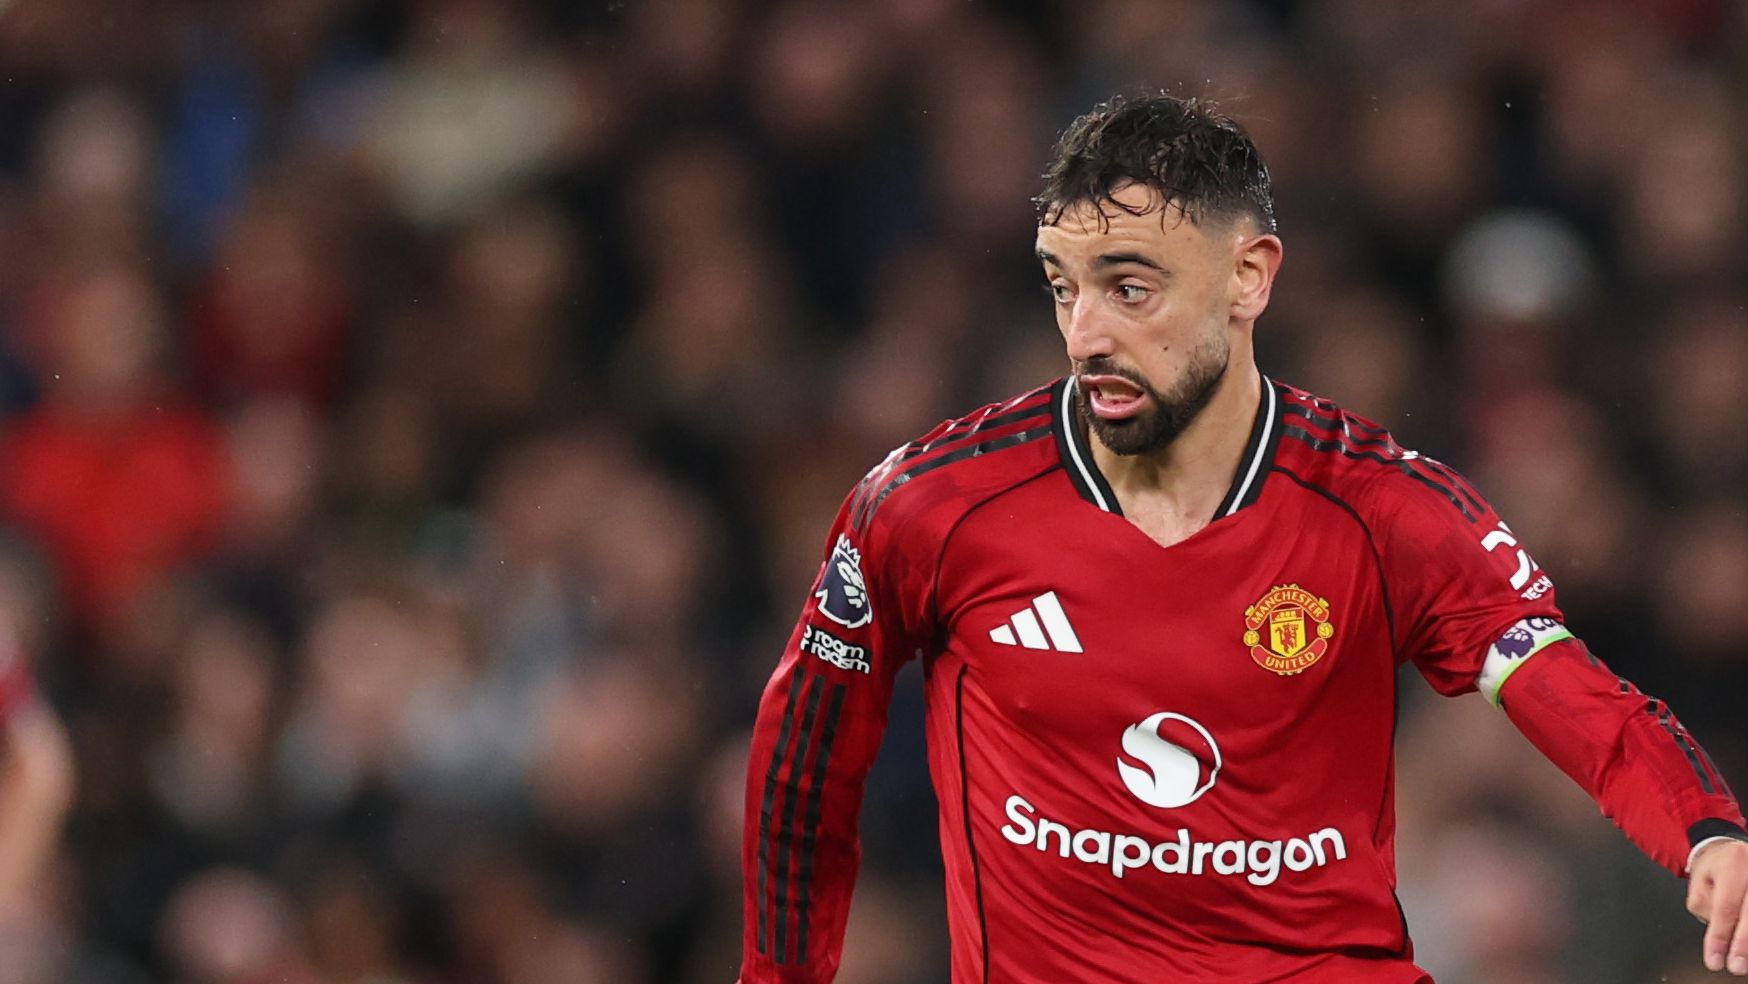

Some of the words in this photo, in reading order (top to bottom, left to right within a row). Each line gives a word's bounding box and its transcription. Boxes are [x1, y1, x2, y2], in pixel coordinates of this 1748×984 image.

[1253, 591, 1323, 624] MANCHESTER
[811, 642, 870, 674] racism
[815, 630, 865, 659] room
[1265, 651, 1315, 669] UNITED
[1001, 795, 1347, 886] Snapdragon
